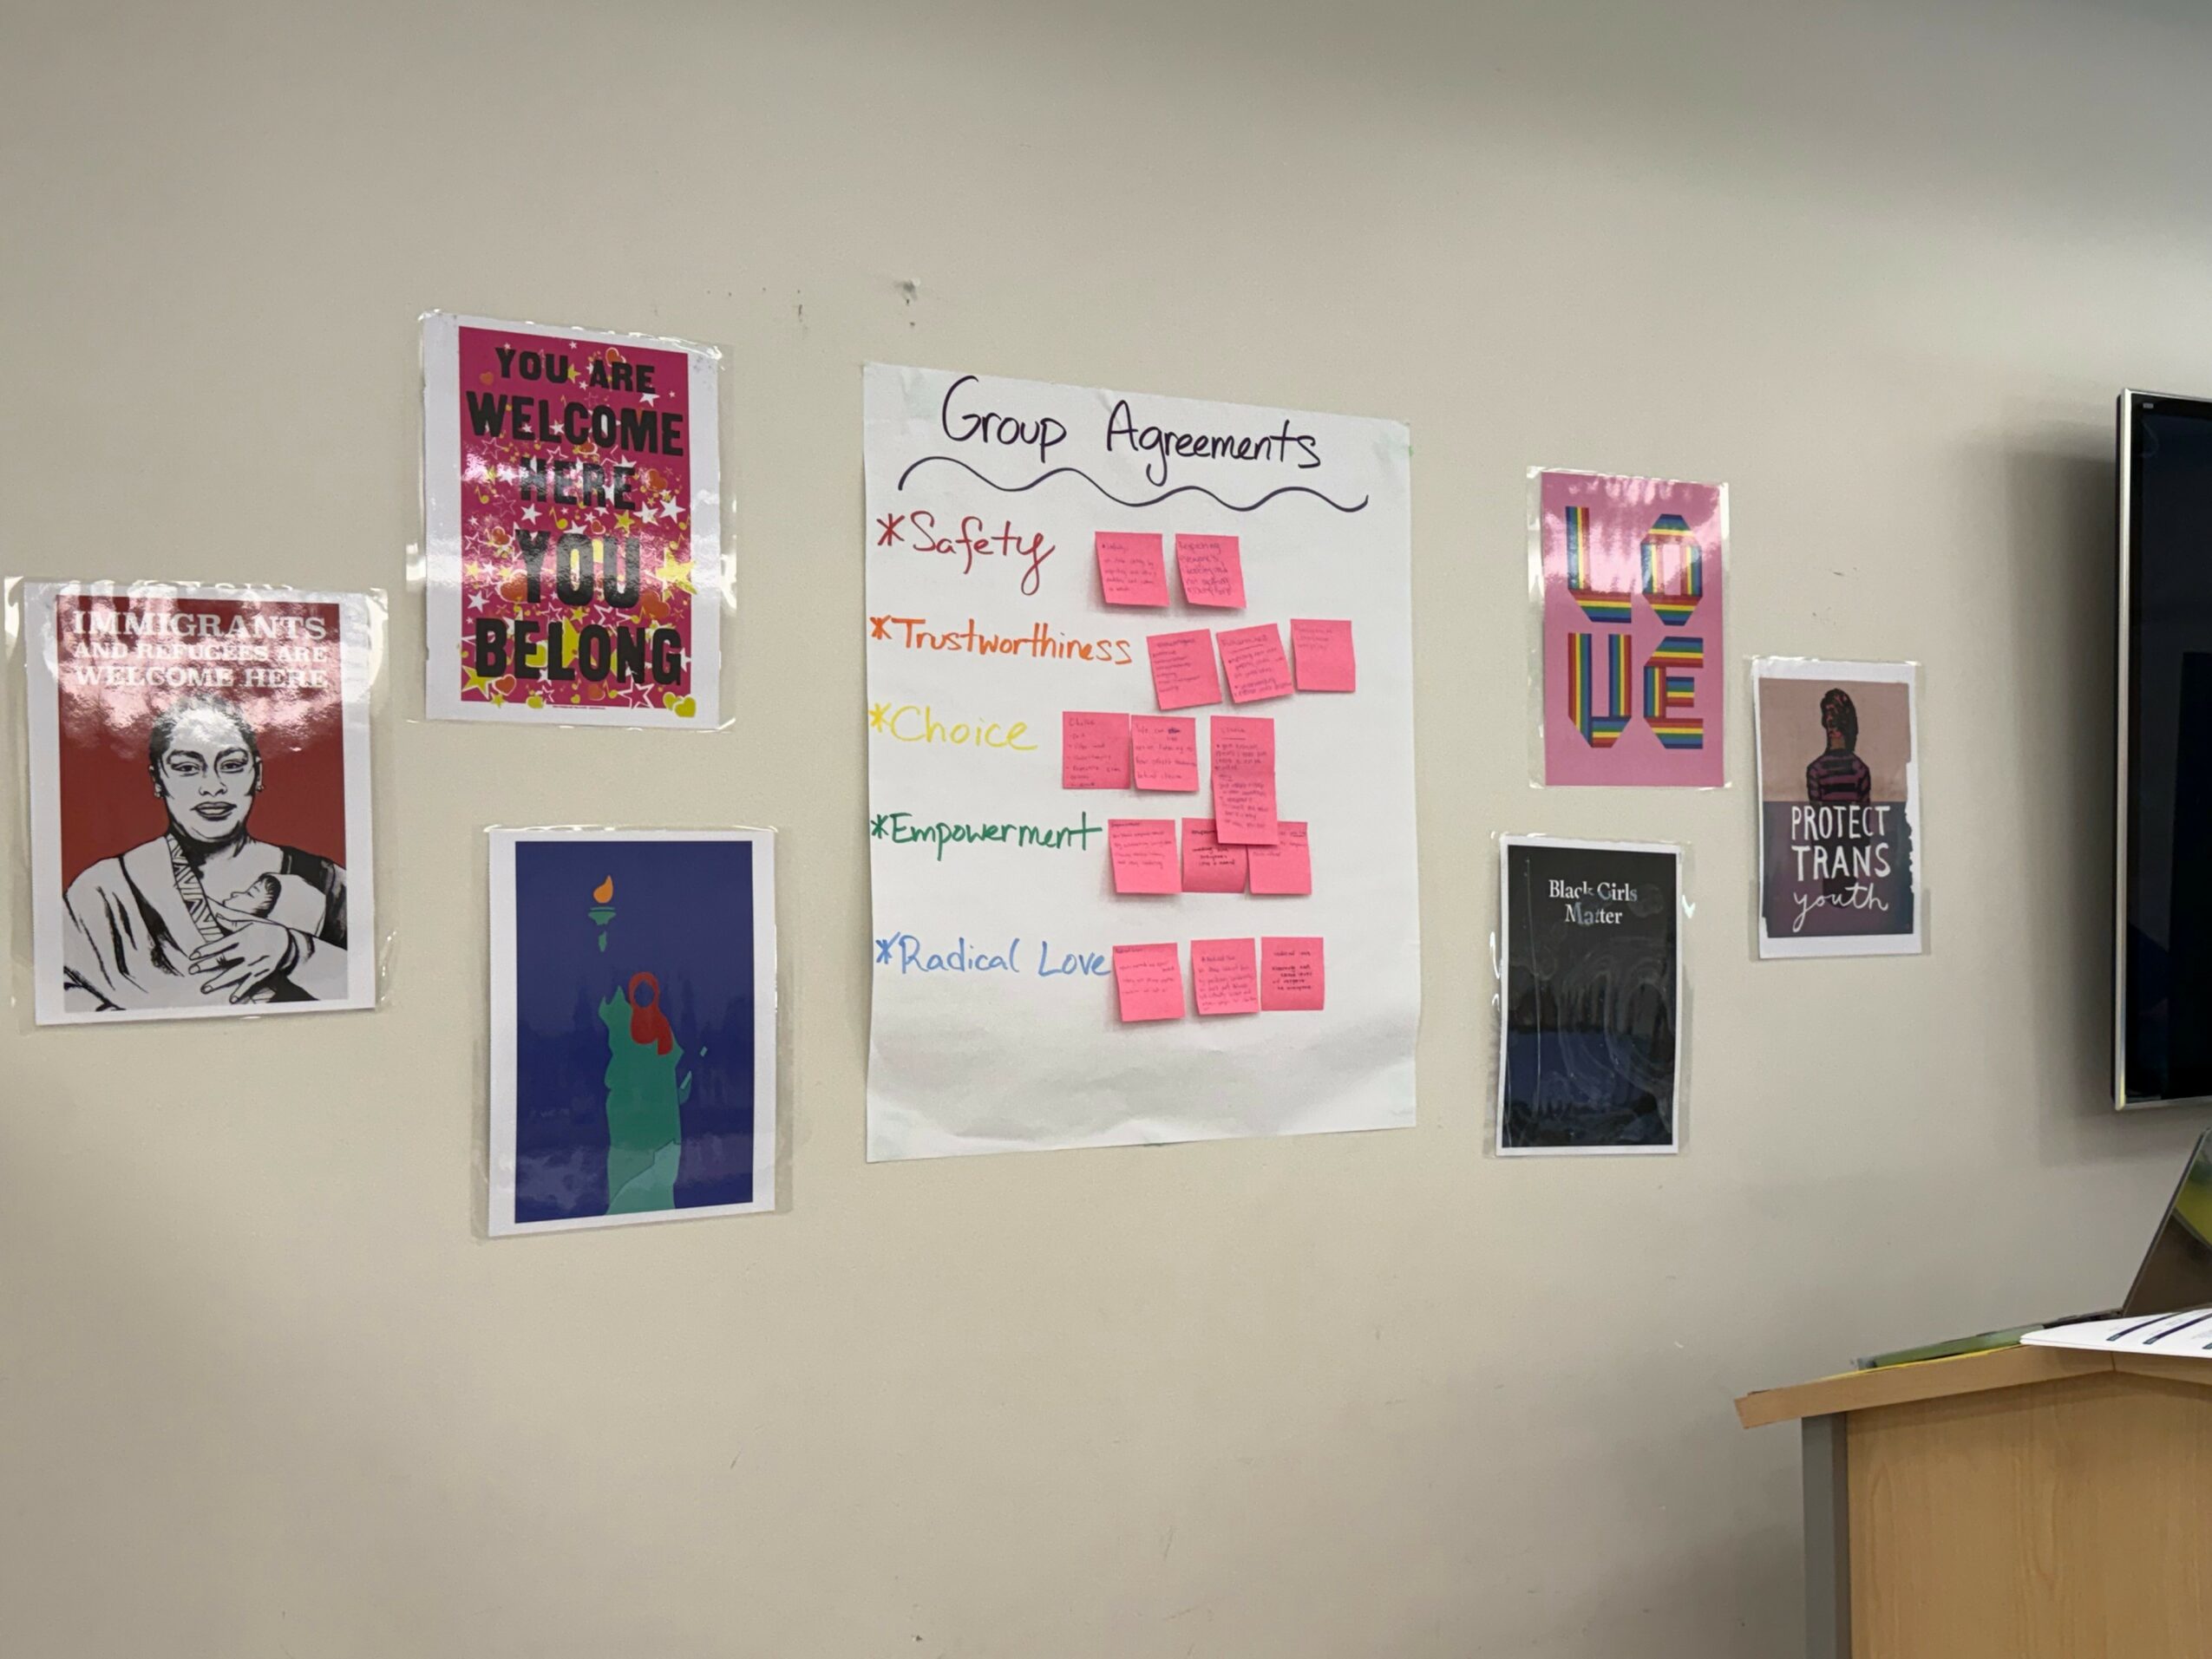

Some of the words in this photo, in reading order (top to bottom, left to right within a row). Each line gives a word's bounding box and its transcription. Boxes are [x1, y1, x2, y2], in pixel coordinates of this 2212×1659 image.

[495, 347, 569, 383] YOU
[590, 359, 656, 395] ARE
[466, 391, 684, 456] WELCOME
[942, 375, 1067, 462] Group
[1106, 400, 1322, 487] Agreements
[520, 457, 636, 510] HERE
[515, 530, 640, 608] YOU
[73, 610, 327, 640] IMMIGRANTS
[74, 642, 128, 659] AND
[134, 643, 268, 662] REFUGEES
[272, 645, 328, 663] ARE
[475, 617, 682, 686] BELONG
[75, 665, 234, 688] WELCOME
[244, 668, 329, 689] HERE
[1791, 805, 1891, 840] PROTECT
[1790, 842, 1891, 881] TRANS
[1548, 879, 1594, 899] Black
[1597, 882, 1639, 902] Girls
[1792, 882, 1889, 933] youth
[1565, 902, 1623, 925] Matter
[1040, 941, 1112, 976] Love
